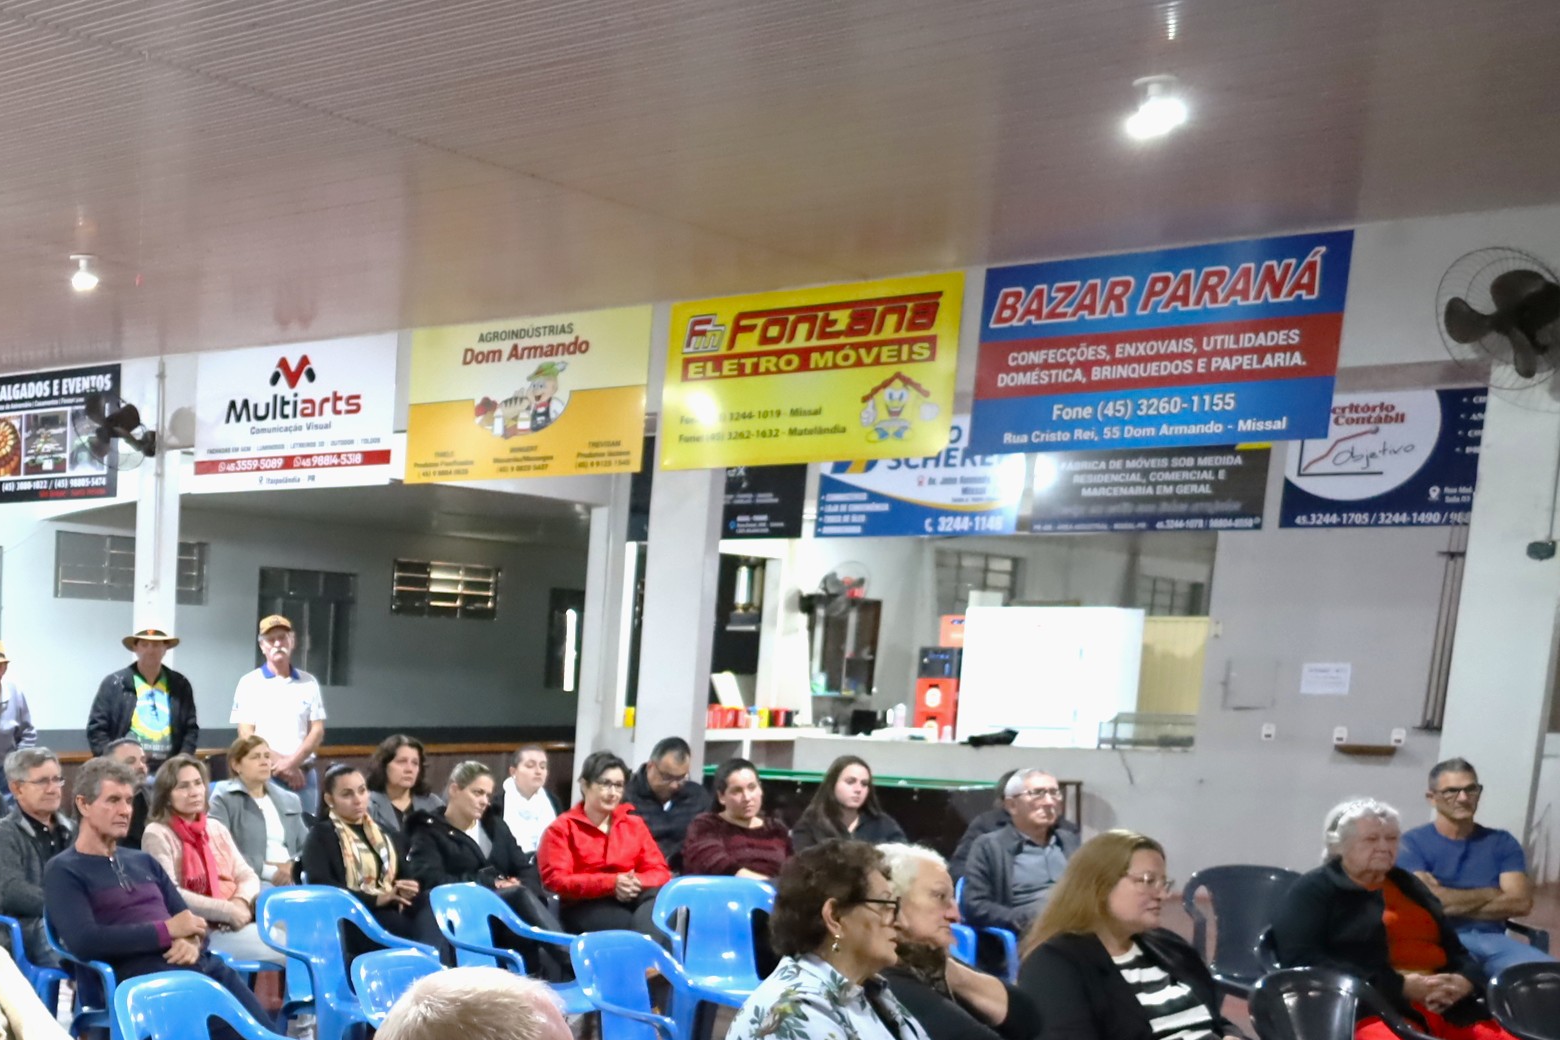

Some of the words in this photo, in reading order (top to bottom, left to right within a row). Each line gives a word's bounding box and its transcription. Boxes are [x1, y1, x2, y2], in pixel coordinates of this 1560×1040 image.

[989, 276, 1135, 329] BAZAR
[1138, 246, 1327, 315] PARANÁ
[477, 322, 575, 343] AGROINDÚSTRIAS
[462, 347, 503, 366] Dom
[507, 335, 591, 362] Armando
[687, 355, 801, 380] ELETRO
[809, 341, 932, 368] MÓVEIS
[1007, 342, 1111, 367] CONFECÇÕES,
[1114, 337, 1198, 359] ENXOVAIS,
[1202, 328, 1301, 352] UTILIDADES
[996, 365, 1088, 388] DOMÉSTICA,
[1090, 361, 1193, 382] BRINQUEDOS
[1196, 359, 1207, 373] E
[1210, 351, 1308, 373] PAPELARIA.
[52, 378, 60, 396] E
[61, 373, 113, 393] EVENTOS
[225, 390, 362, 424] Multiarts
[1051, 403, 1093, 421] Fone
[1096, 400, 1133, 422] (45)
[1136, 393, 1237, 417] 3260-1155
[1333, 412, 1406, 426] Contábil
[249, 423, 303, 436] Comunicação
[306, 420, 333, 432] Visual
[1003, 432, 1029, 444] Rua
[1031, 430, 1071, 443] Cristo
[1073, 428, 1099, 442] Rei,
[1103, 426, 1121, 440] 55
[1123, 424, 1156, 438] Dom
[1159, 420, 1224, 437] Armando
[1237, 416, 1288, 433] Missal
[1109, 458, 1123, 470] DE
[1171, 456, 1194, 467] SOB
[1197, 454, 1244, 466] MEDIDA
[1332, 441, 1416, 470] Objetivo
[1149, 470, 1215, 482] COMERCIAL
[1175, 484, 1213, 495] GERAL
